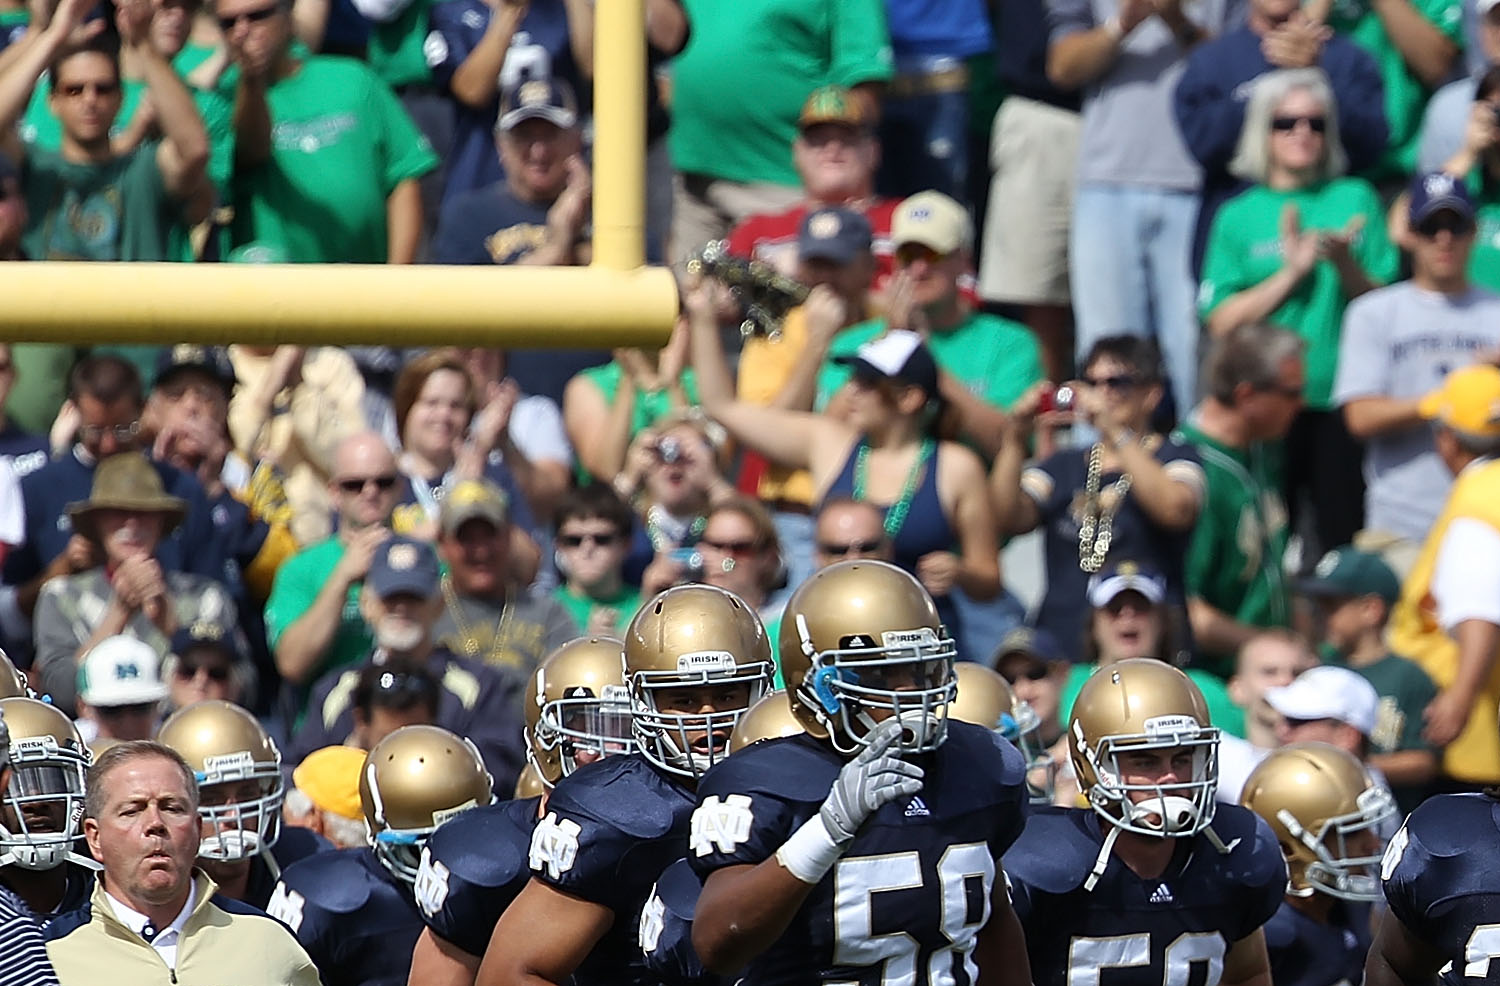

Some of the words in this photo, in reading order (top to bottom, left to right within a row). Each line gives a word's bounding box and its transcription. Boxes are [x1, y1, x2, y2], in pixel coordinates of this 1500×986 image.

[691, 655, 719, 663] IRISH
[1158, 719, 1183, 727] IRISH
[18, 741, 43, 750] IRISH
[905, 808, 930, 816] adidas
